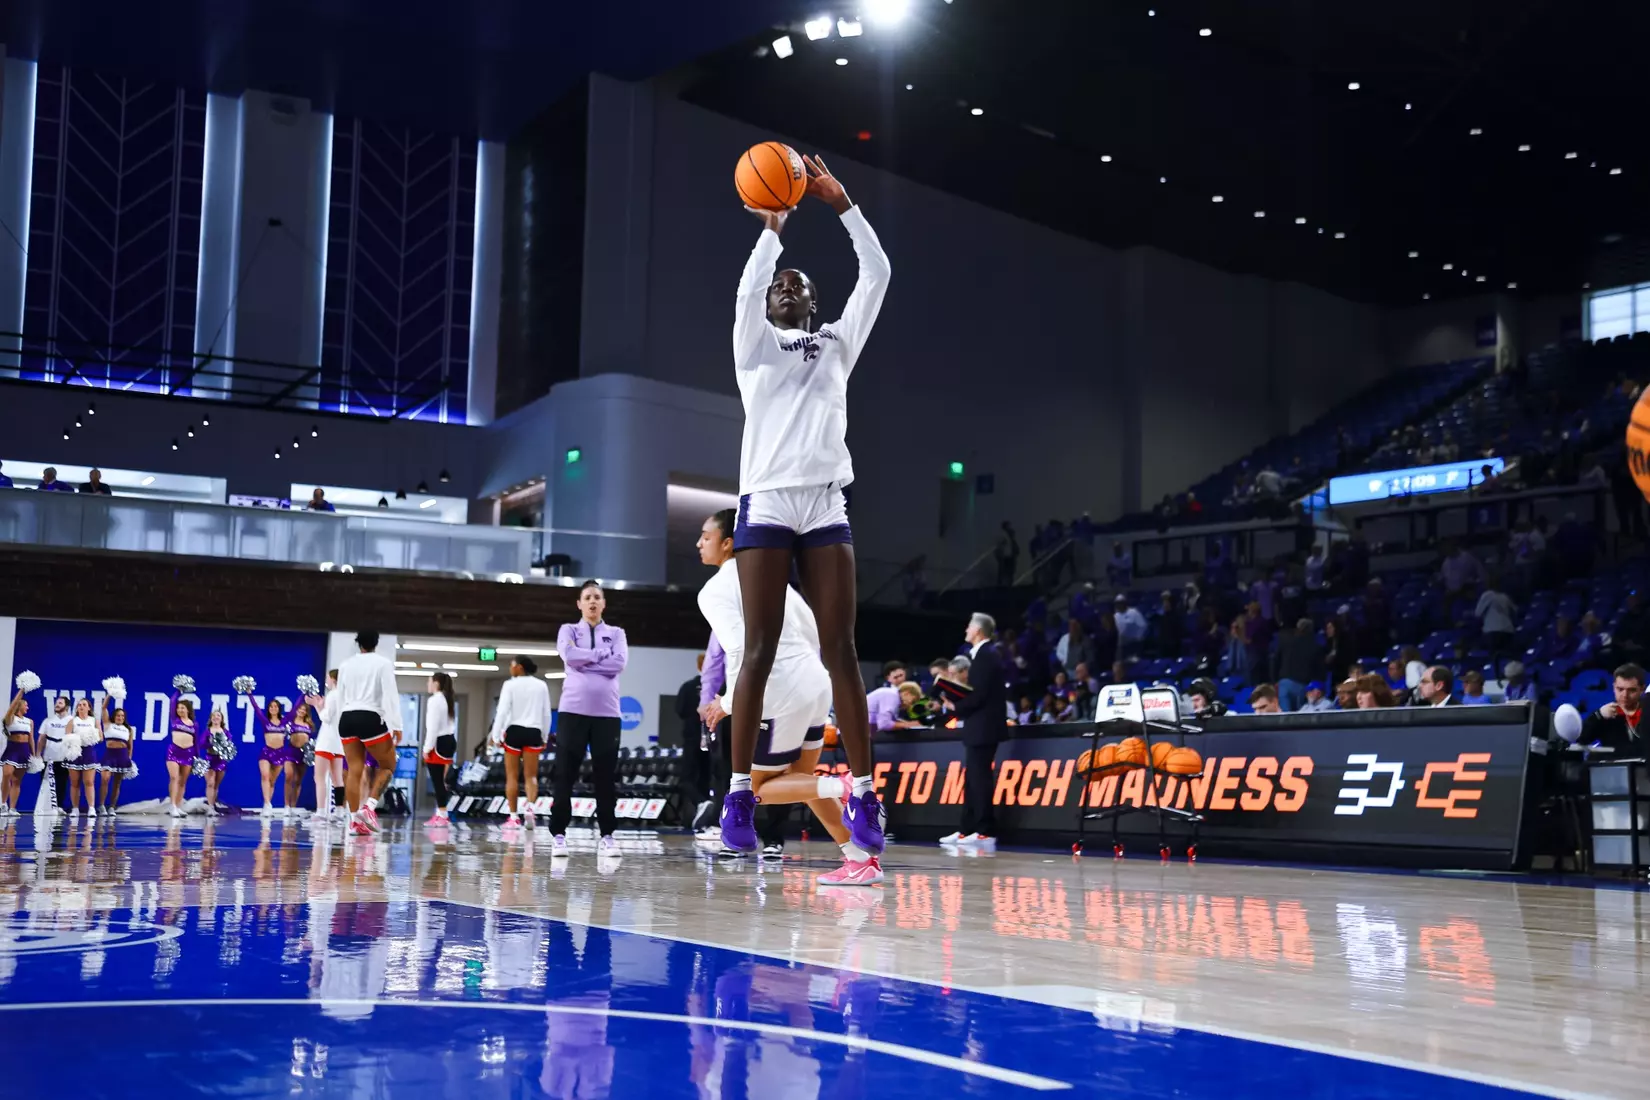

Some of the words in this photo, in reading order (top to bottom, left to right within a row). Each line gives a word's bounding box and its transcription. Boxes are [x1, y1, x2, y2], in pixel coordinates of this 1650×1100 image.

[1143, 697, 1171, 710] Wilson
[894, 761, 938, 805] TO
[939, 760, 1077, 807] MRCH
